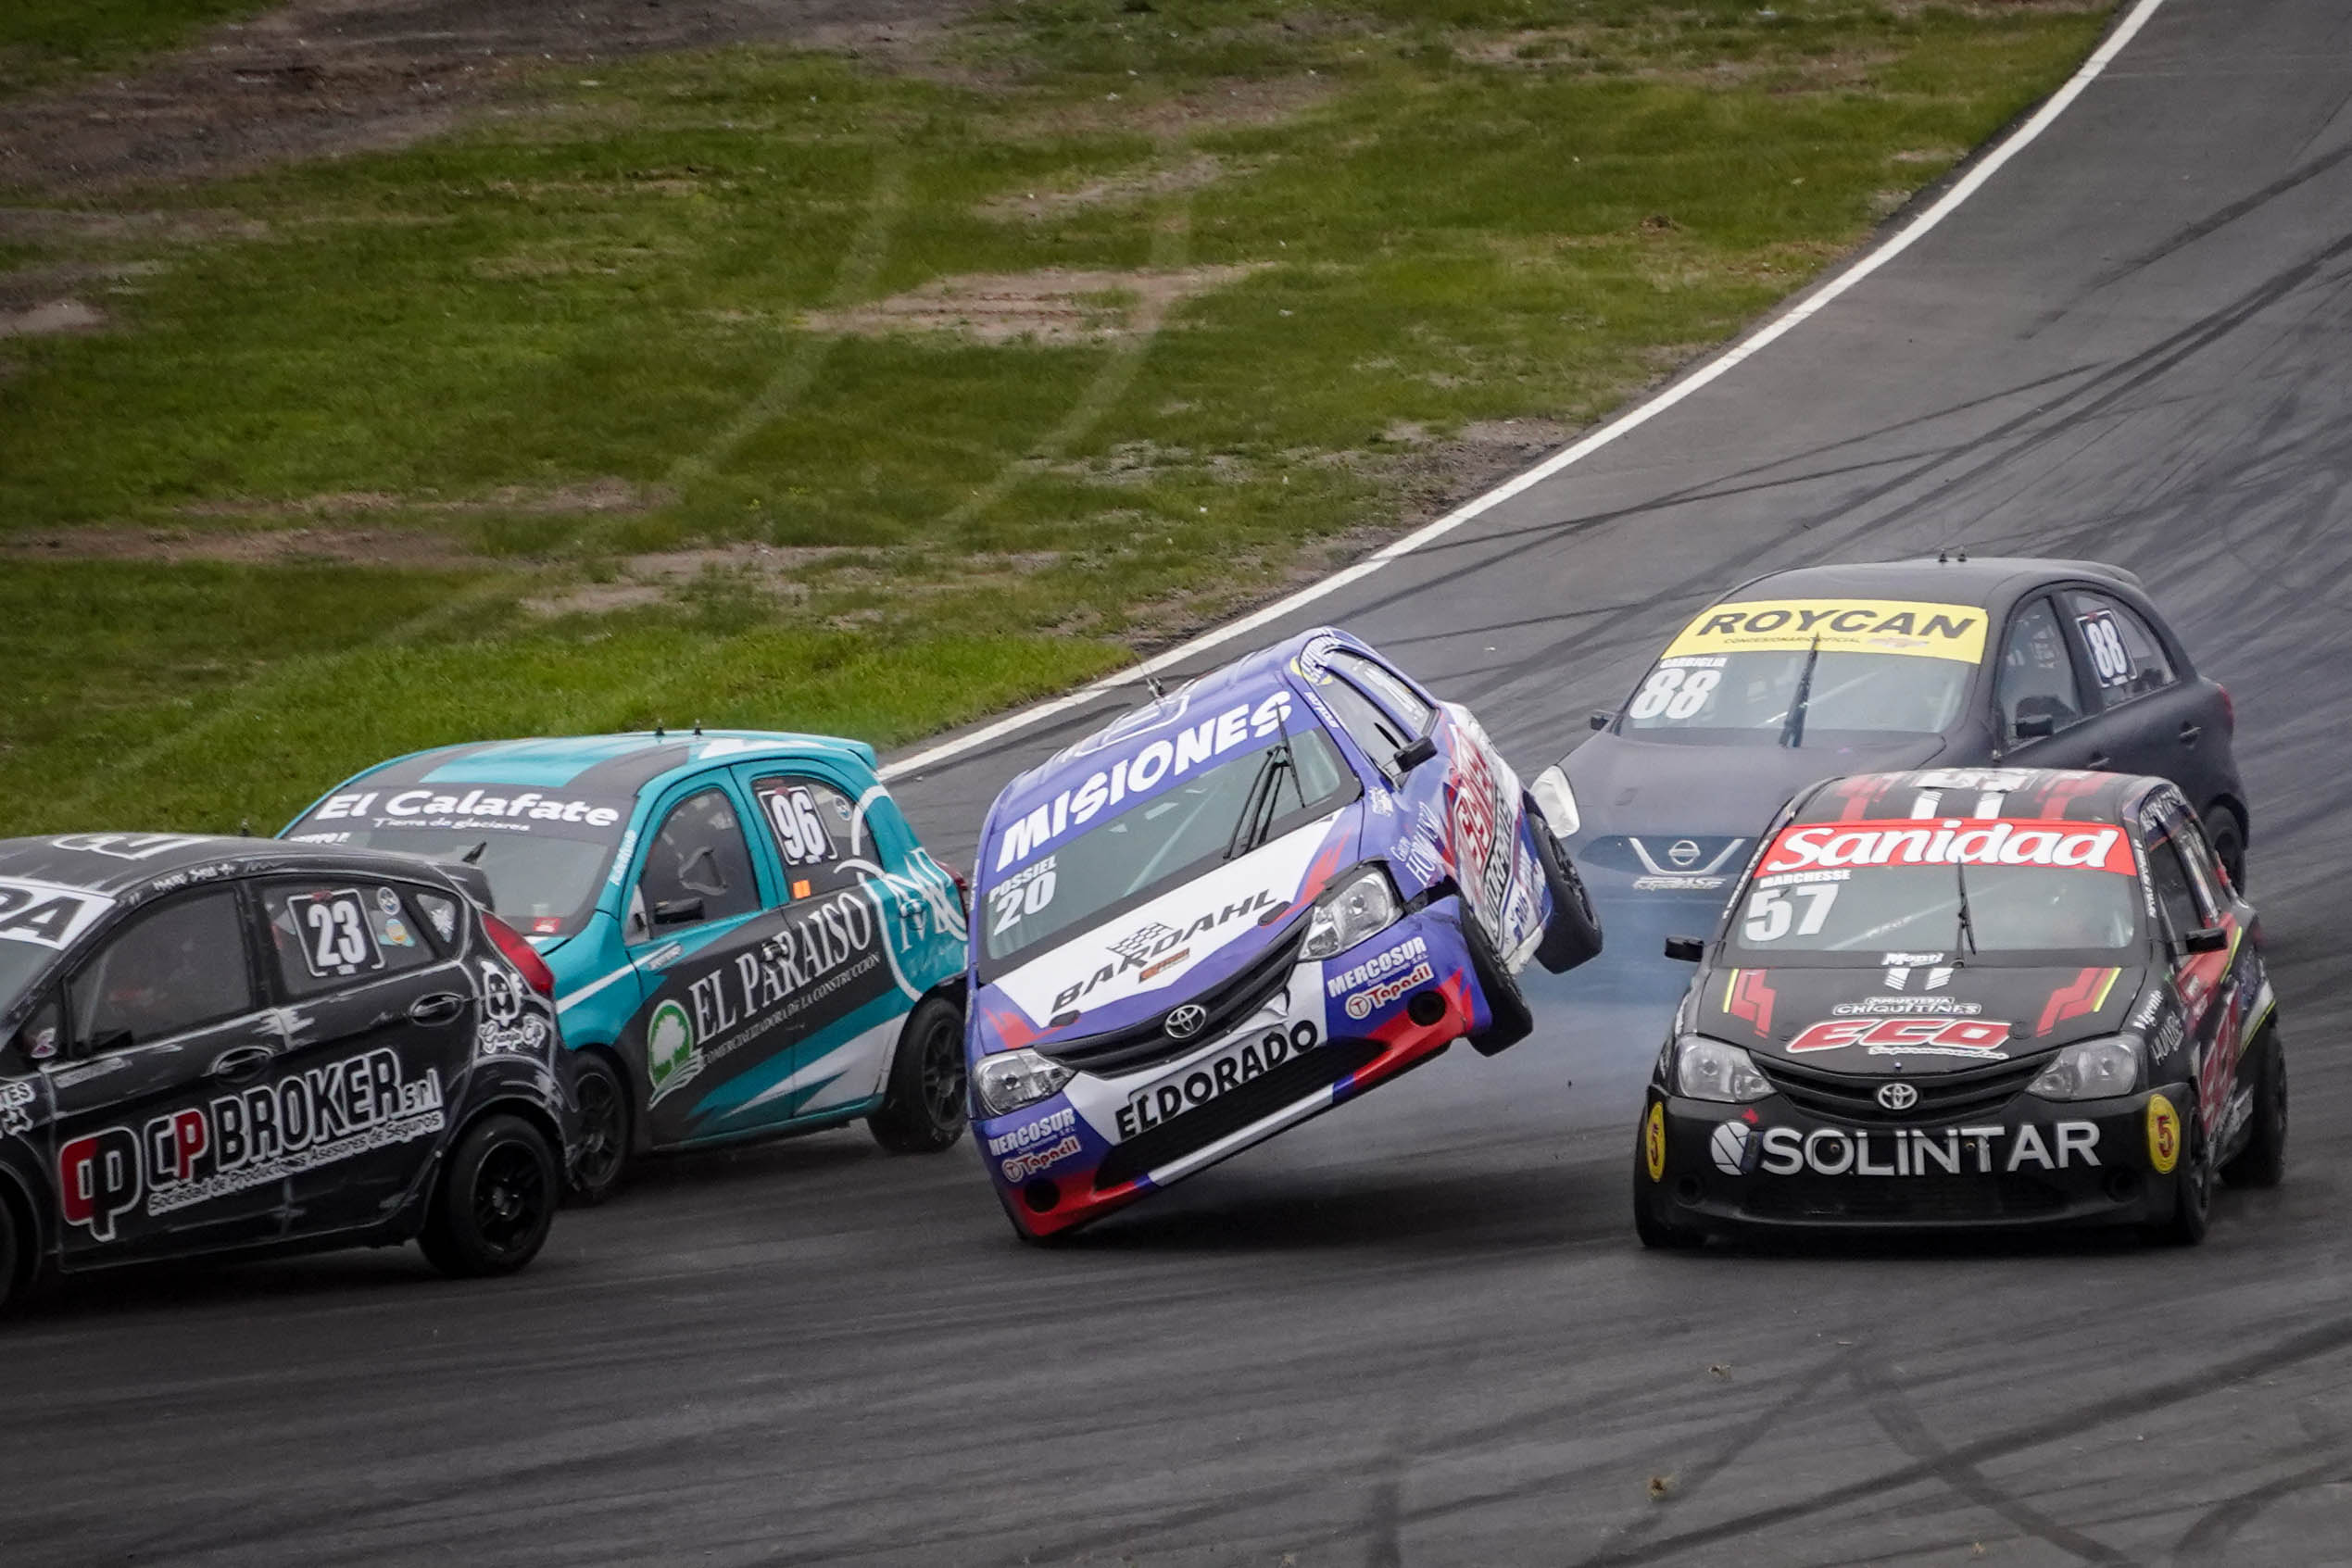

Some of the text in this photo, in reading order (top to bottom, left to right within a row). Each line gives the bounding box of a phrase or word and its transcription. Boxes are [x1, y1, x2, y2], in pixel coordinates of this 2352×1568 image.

[1697, 609, 1977, 639] ROYCAN
[2086, 619, 2128, 678] 88
[1629, 668, 1722, 719] 88
[316, 790, 619, 826] El Calafate
[996, 691, 1292, 872] MISIONES
[771, 792, 825, 859] 96
[1767, 820, 2119, 872] Sanidad
[988, 855, 1056, 903] POSSIEL
[993, 871, 1056, 935] 20
[1759, 869, 1852, 888] MARCHESSE
[308, 899, 367, 967] 23
[1744, 884, 1839, 942] 57
[688, 970, 736, 1046] EL
[735, 892, 871, 1019] PARAISO
[1051, 889, 1277, 1014] BARDAHL
[1327, 936, 1427, 997] MERCOSUR
[1365, 965, 1432, 1007] Tapacil
[1786, 1019, 2012, 1053] ECO
[1116, 1020, 1317, 1141] ELDORADO
[988, 1108, 1075, 1156] MERCOSUR
[1763, 1122, 2102, 1176] SOLINTAR
